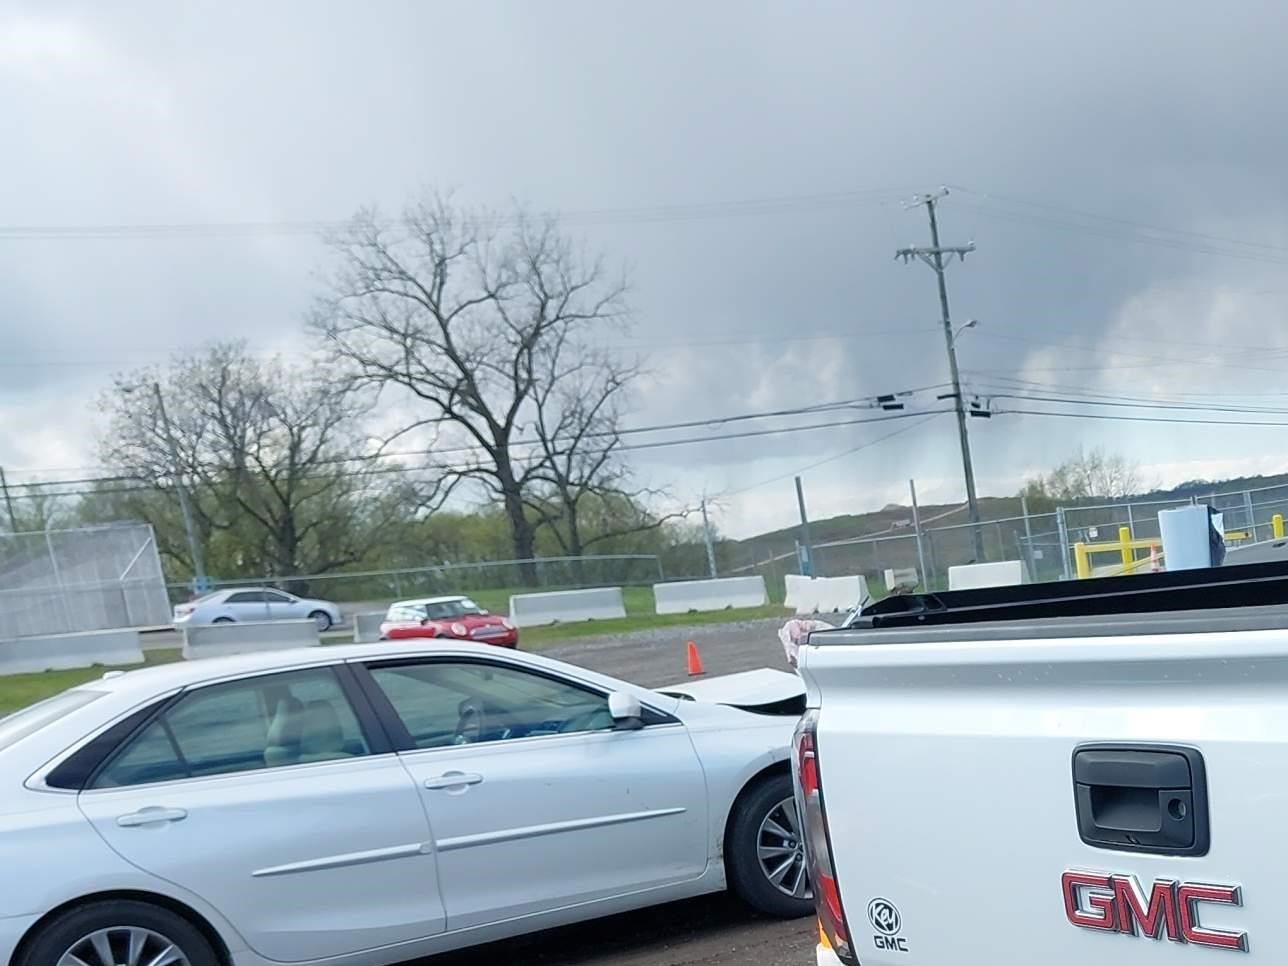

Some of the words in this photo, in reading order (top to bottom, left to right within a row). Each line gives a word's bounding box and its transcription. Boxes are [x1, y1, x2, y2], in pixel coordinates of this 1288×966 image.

[871, 902, 897, 931] Key
[1061, 869, 1250, 953] GMC
[873, 935, 909, 953] GMC
